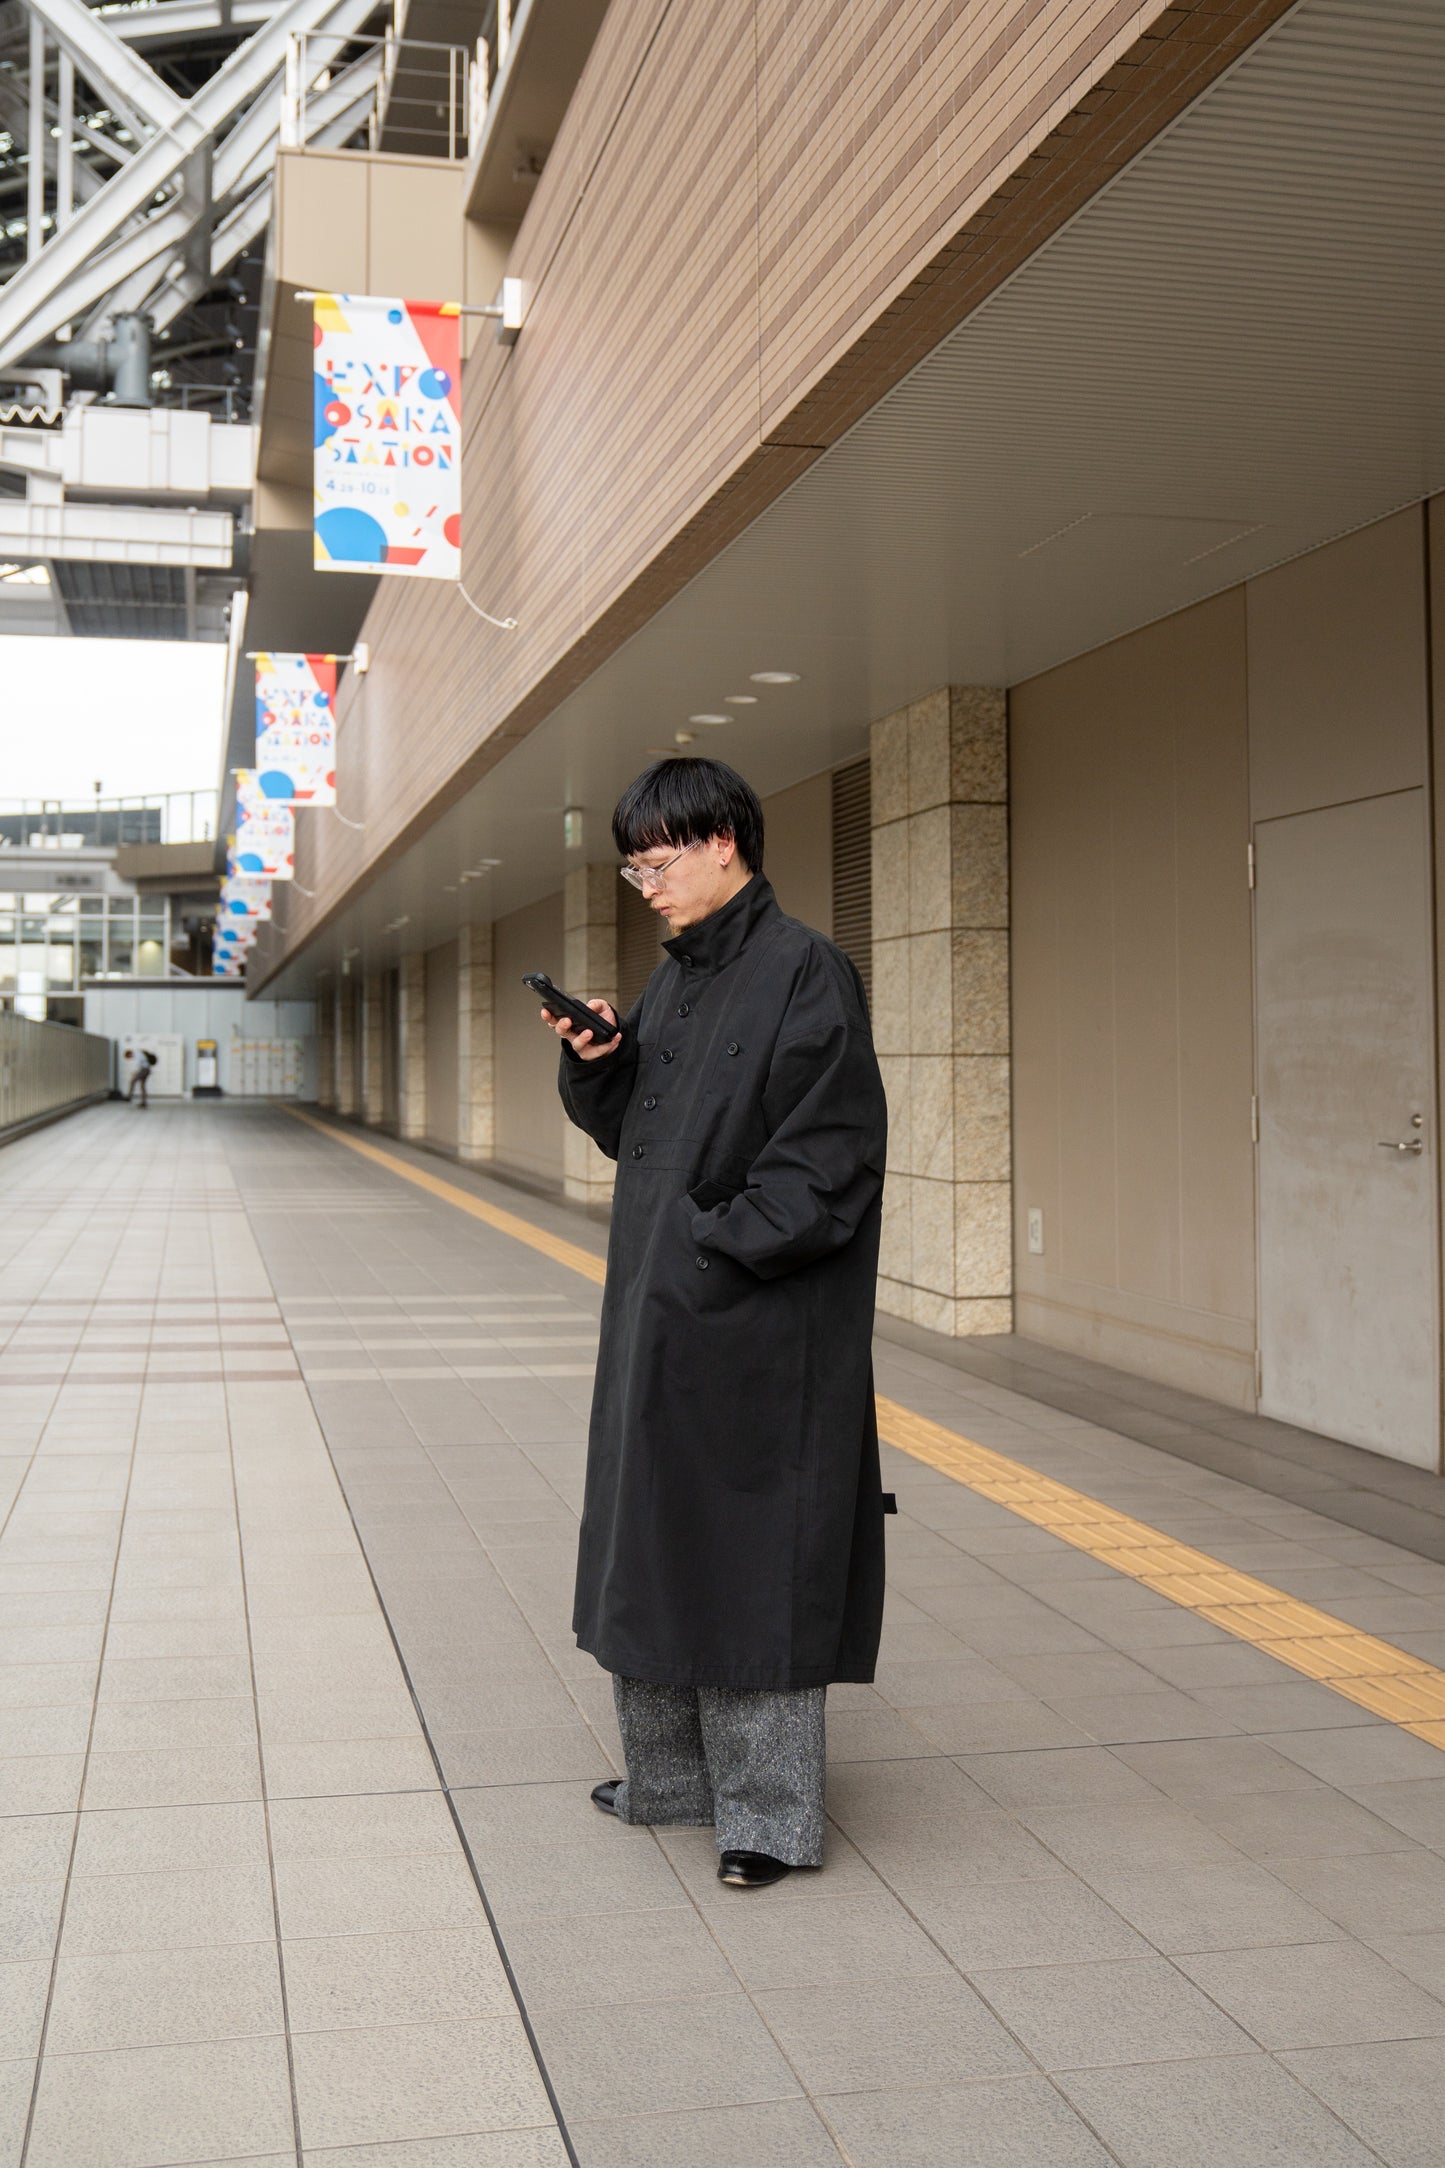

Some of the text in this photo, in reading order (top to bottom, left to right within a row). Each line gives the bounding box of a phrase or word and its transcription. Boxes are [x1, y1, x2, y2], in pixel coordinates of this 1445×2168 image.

[326, 360, 452, 400] EXPO
[324, 399, 450, 434] OSAKA
[325, 436, 453, 470] STATION
